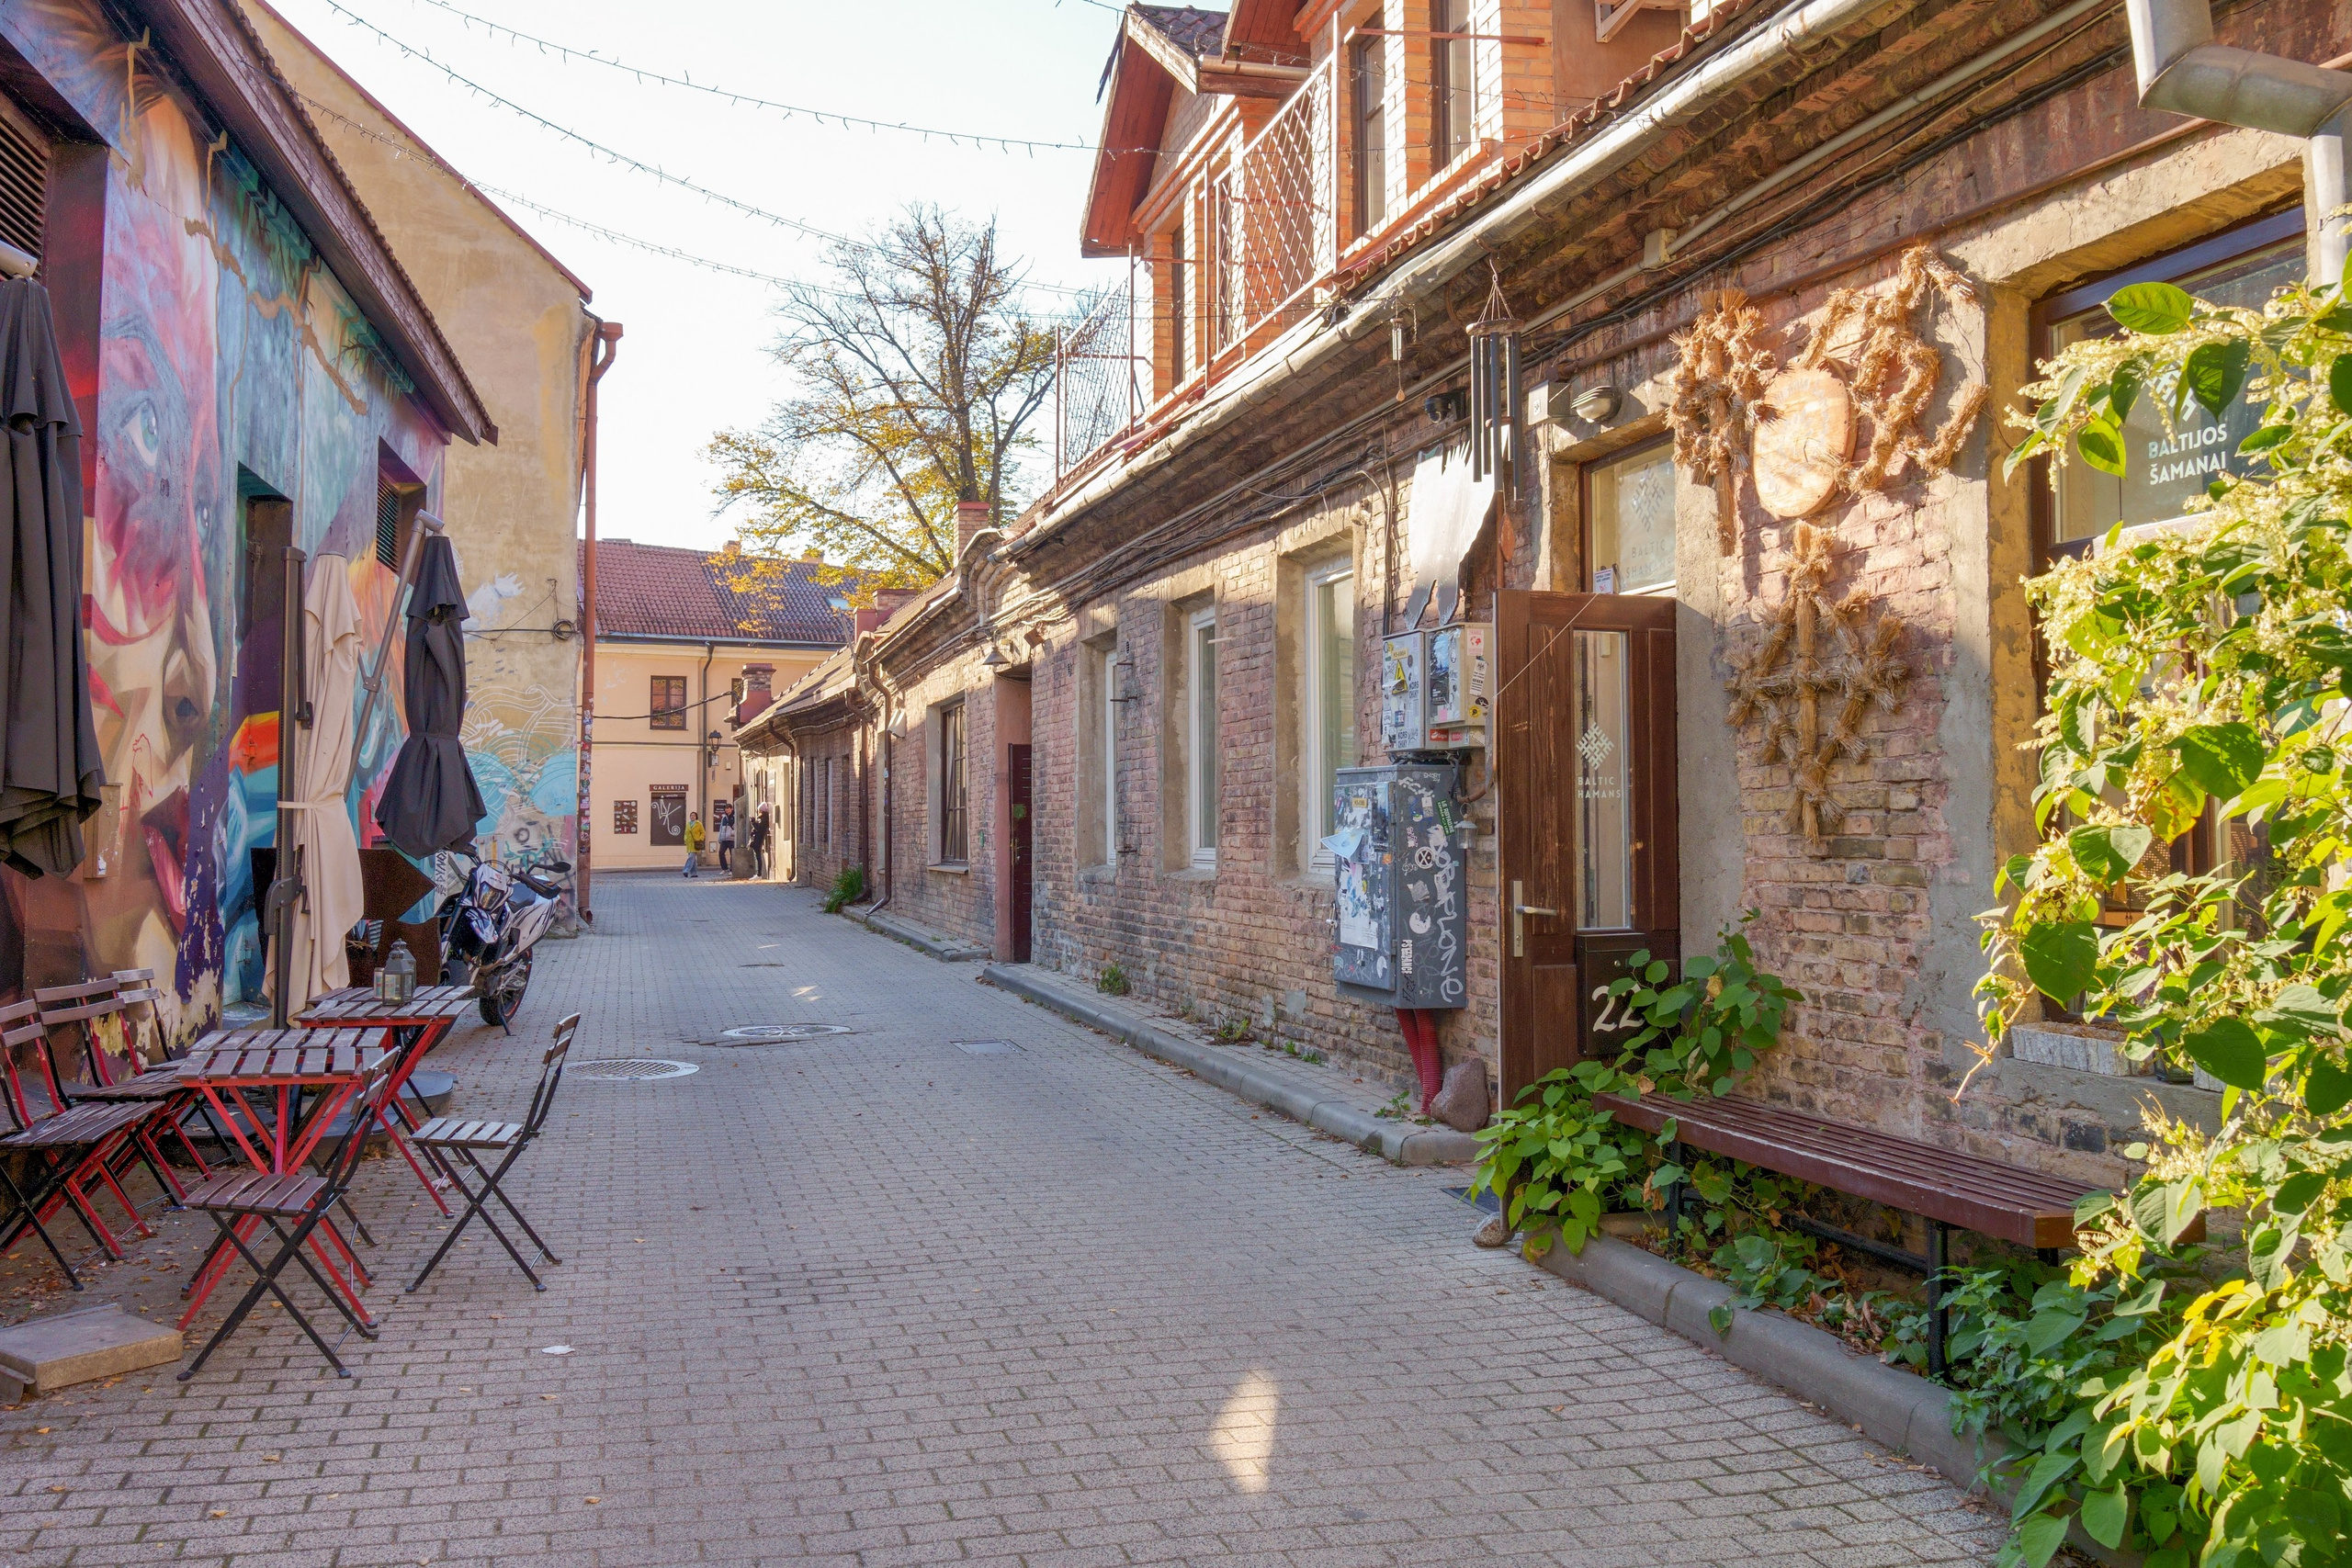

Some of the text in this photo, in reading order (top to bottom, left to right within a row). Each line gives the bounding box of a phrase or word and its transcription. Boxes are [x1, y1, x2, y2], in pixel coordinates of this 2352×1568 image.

[2148, 423, 2228, 459] BALTIJOS
[2150, 450, 2226, 486] ŠAMANAI
[1632, 538, 1666, 558] BALTIC
[1577, 776, 1614, 785] BALTIC
[1591, 983, 1645, 1032] 22
